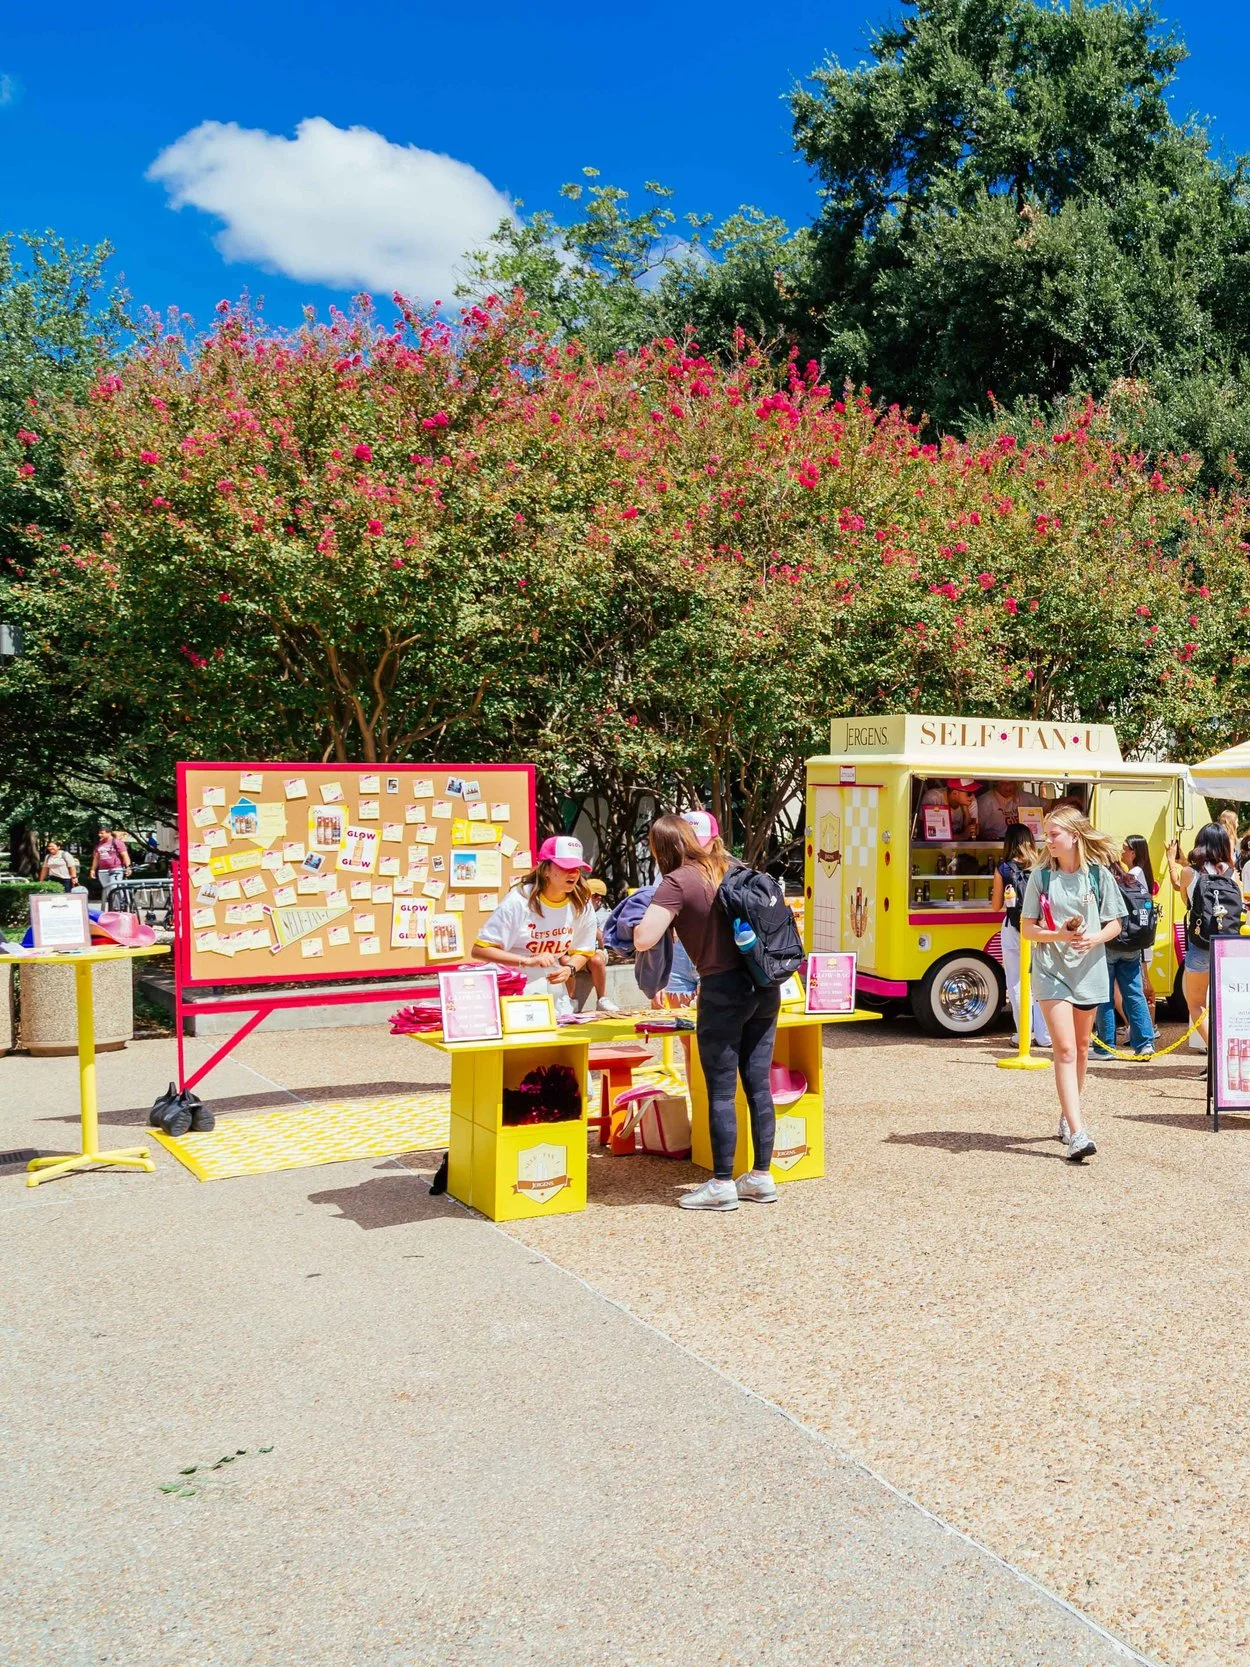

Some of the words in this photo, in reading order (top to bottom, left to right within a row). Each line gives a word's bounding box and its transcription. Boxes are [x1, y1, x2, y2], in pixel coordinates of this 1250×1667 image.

[844, 722, 889, 752] JERGENS
[920, 722, 996, 747] SELF
[1012, 726, 1069, 750] TAN
[1085, 730, 1103, 752] U
[347, 830, 376, 840] GLOW
[341, 858, 371, 868] GLW
[400, 904, 428, 912] GLOW
[398, 932, 427, 940] GLW
[530, 928, 550, 939] LET'S
[552, 926, 574, 937] GLOW
[525, 940, 572, 954] GIRLS
